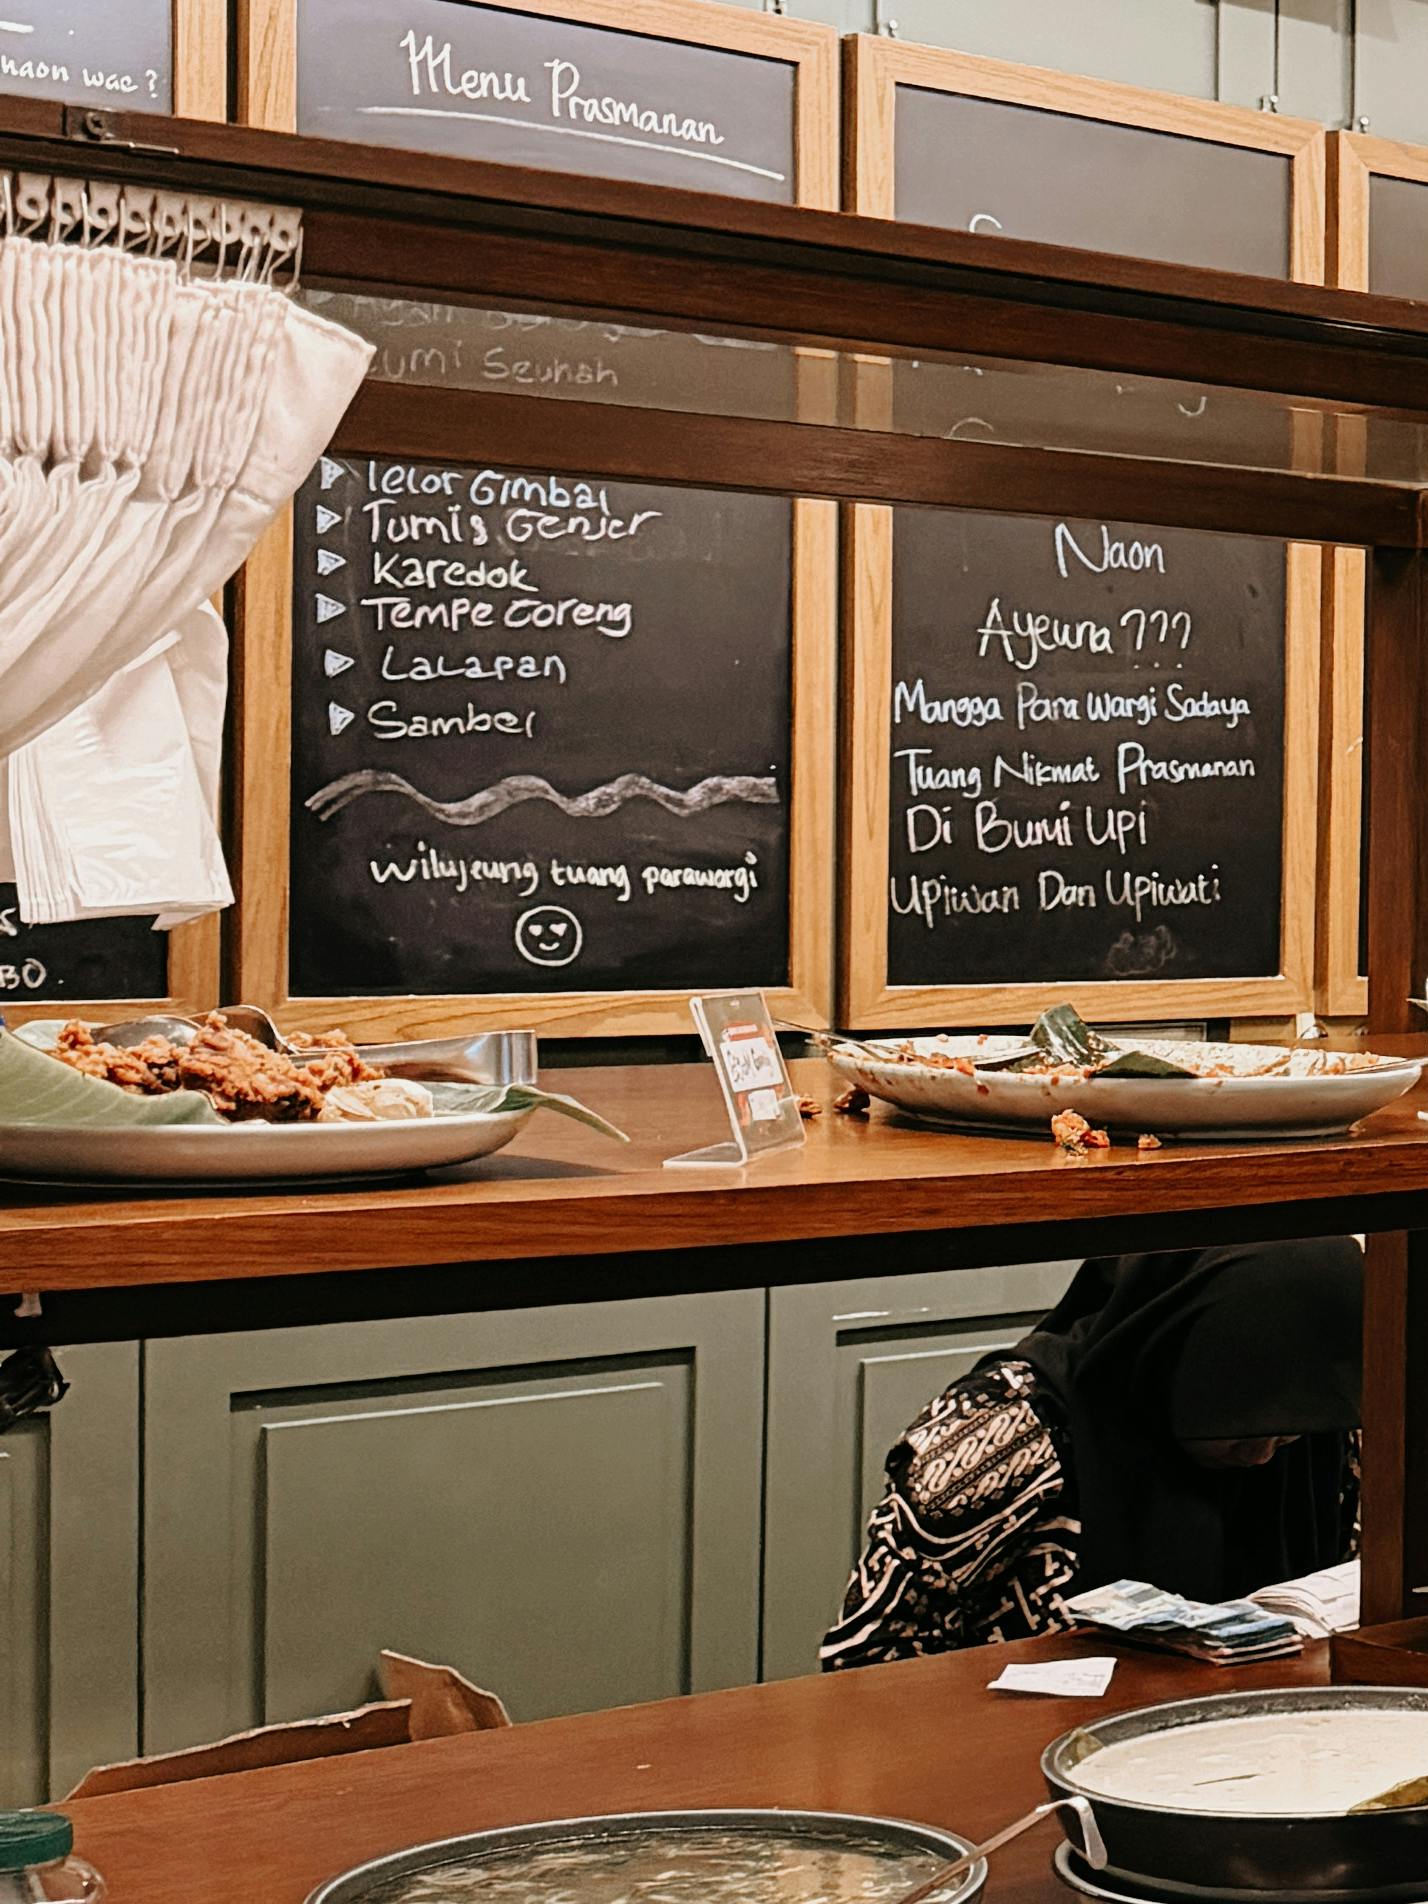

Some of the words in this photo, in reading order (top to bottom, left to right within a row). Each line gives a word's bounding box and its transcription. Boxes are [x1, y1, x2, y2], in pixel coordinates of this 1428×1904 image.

[399, 29, 531, 104] Menu
[544, 58, 725, 146] Prasmanan
[372, 339, 462, 379] umi
[372, 551, 539, 592] Karedok
[1053, 523, 1166, 579] Naon
[894, 678, 1005, 728] Mangga
[1016, 680, 1080, 731] Para
[1087, 687, 1160, 727] Wargi
[894, 748, 983, 798] Tuang
[994, 751, 1101, 789] Nikmat
[1117, 742, 1257, 794] Prasmanan
[907, 804, 953, 854] Di
[975, 799, 1074, 854] Bumi
[549, 858, 631, 901] tuang
[1038, 870, 1097, 912] Dan
